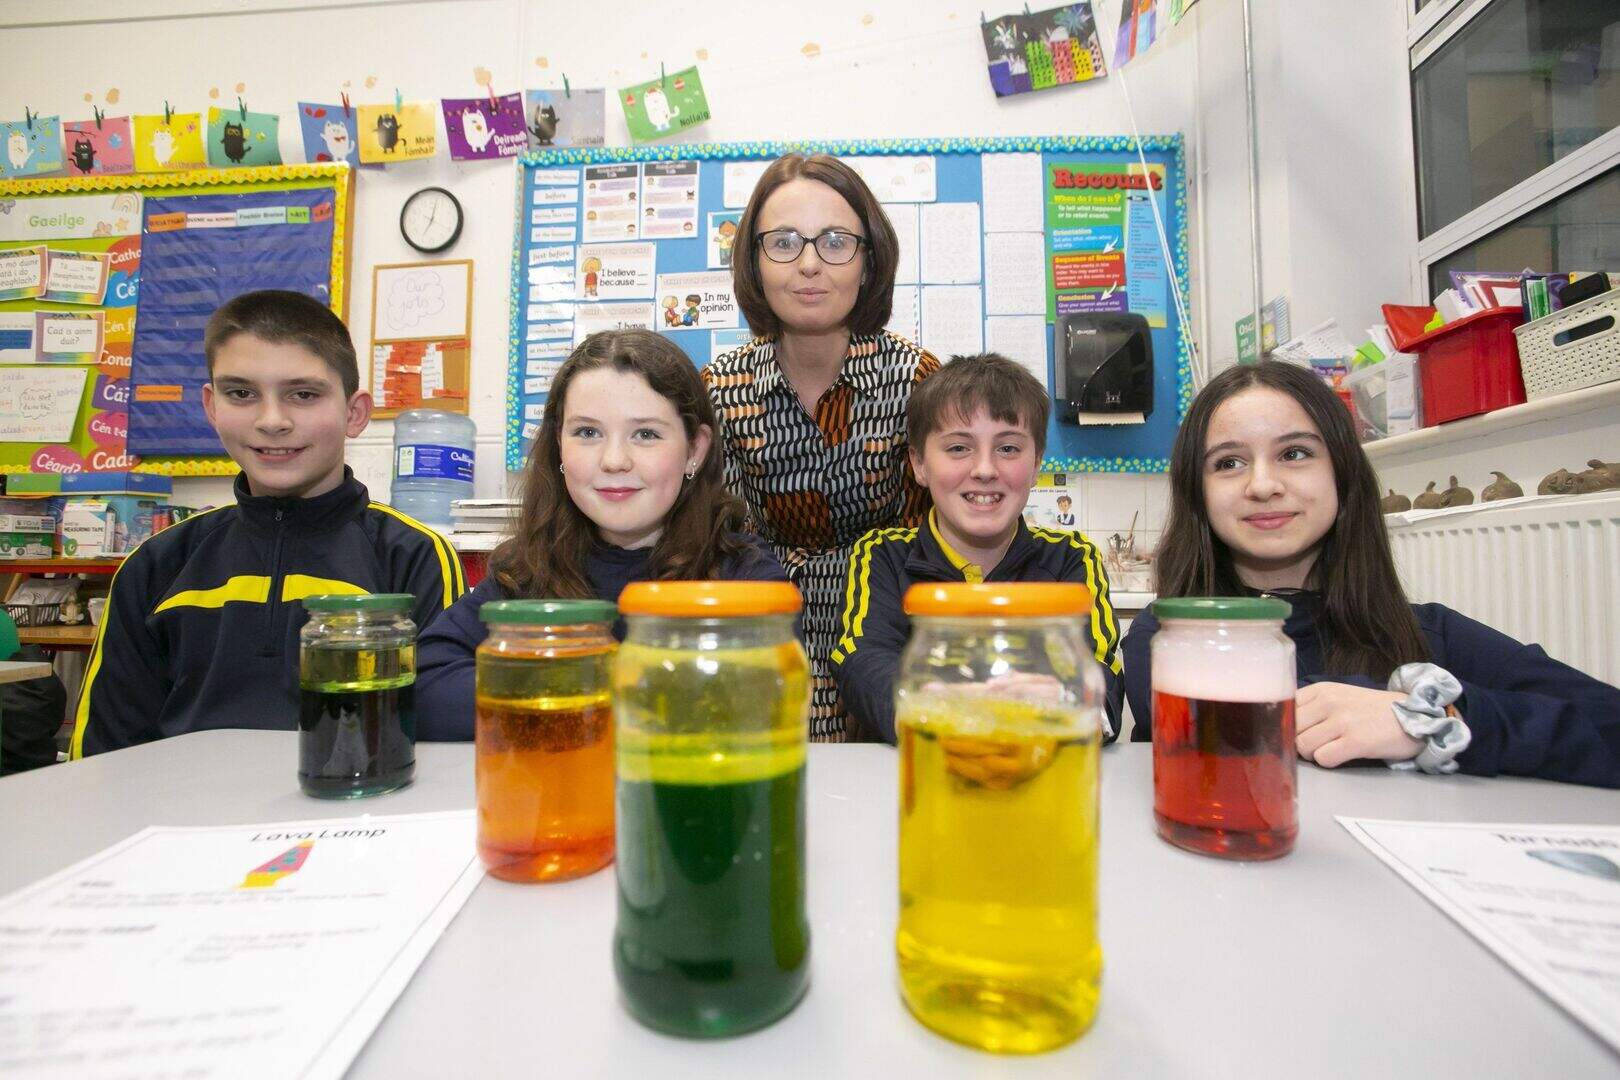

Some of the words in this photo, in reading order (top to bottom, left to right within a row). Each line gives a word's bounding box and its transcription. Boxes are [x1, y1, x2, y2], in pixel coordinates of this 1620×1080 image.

[679, 111, 710, 127] Nollaig
[1054, 168, 1163, 190] Recount
[29, 213, 85, 229] Gaeilge
[548, 250, 570, 260] before
[607, 269, 636, 277] believe
[704, 293, 714, 301] In
[716, 294, 730, 303] my
[700, 303, 733, 314] opinion
[47, 326, 63, 336] Cad
[91, 419, 111, 434] Cén
[250, 829, 315, 842] Lava
[318, 827, 387, 841] Lamp
